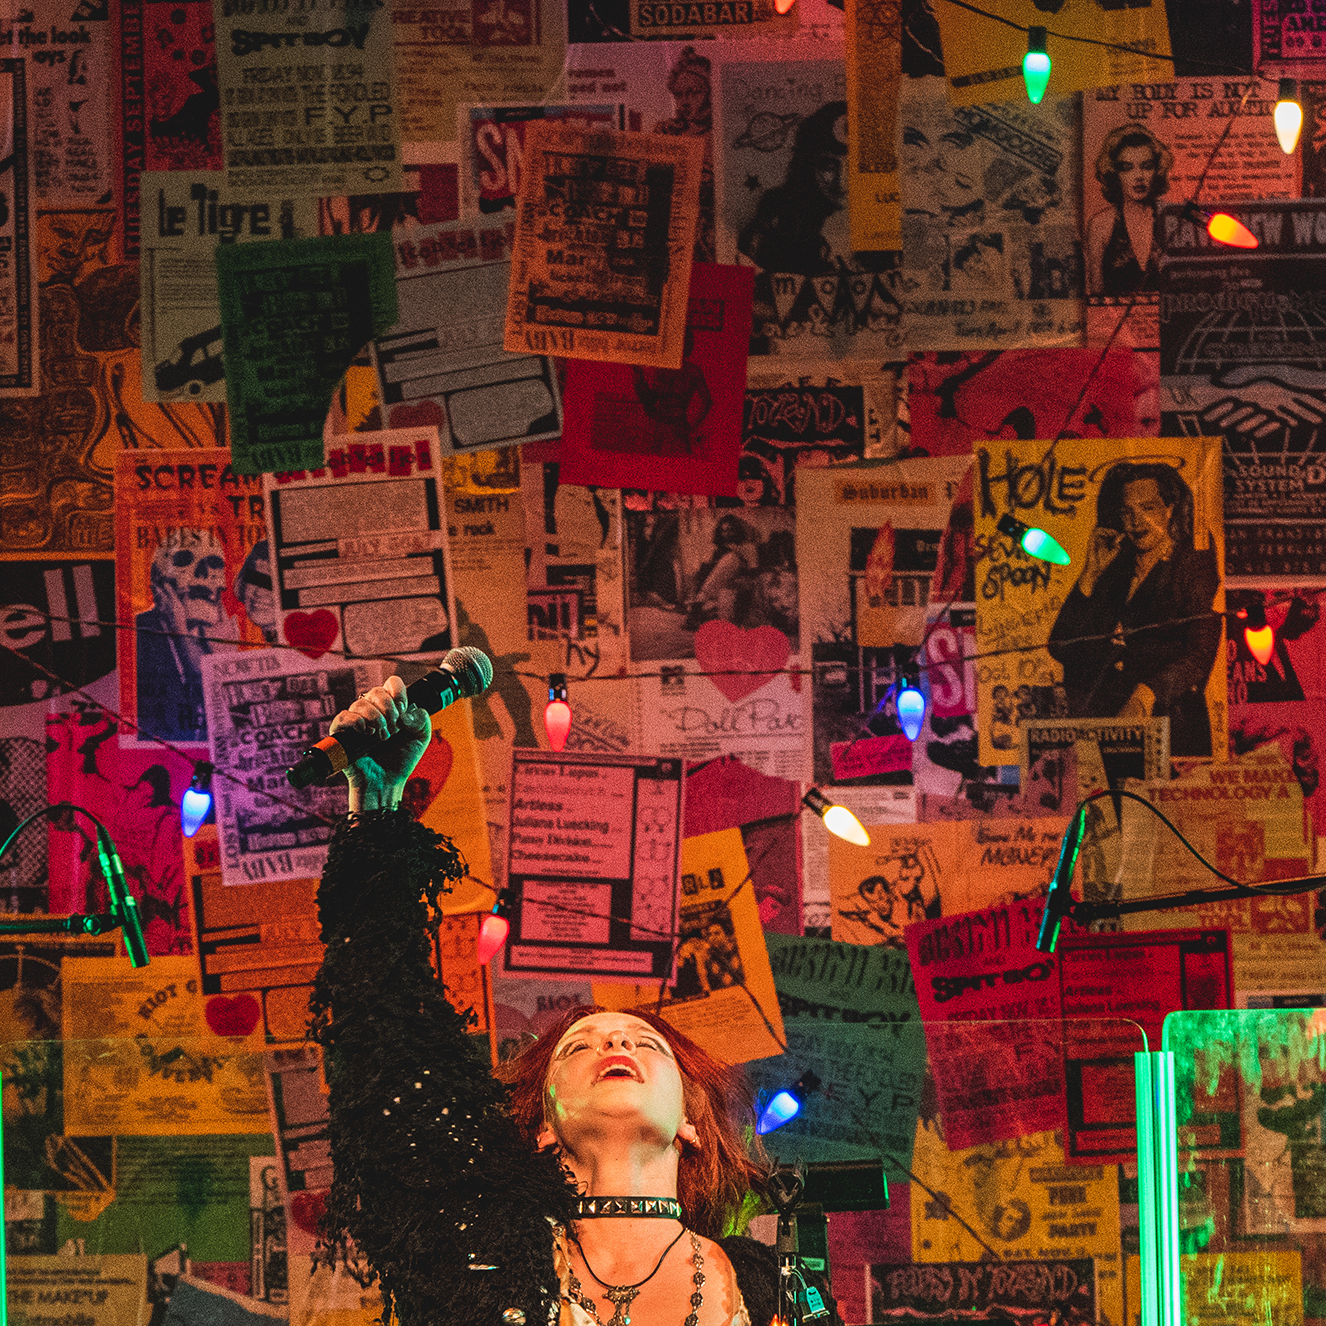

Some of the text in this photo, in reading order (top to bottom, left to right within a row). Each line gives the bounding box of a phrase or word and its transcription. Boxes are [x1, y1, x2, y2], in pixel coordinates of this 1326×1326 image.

[393, 9, 471, 23] REATIVE
[18, 27, 90, 48] the look
[231, 23, 370, 55] SPITBOY
[121, 0, 144, 132] SEPTEMBE
[1131, 81, 1262, 101] BODY IS NOT
[1127, 102, 1203, 121] UP FOR
[1238, 464, 1303, 479] SOUND
[979, 448, 1089, 518] HOLE
[1236, 480, 1305, 493] SYSTEM
[1209, 771, 1240, 786] WE
[1148, 786, 1272, 801] TECHNOLOGY
